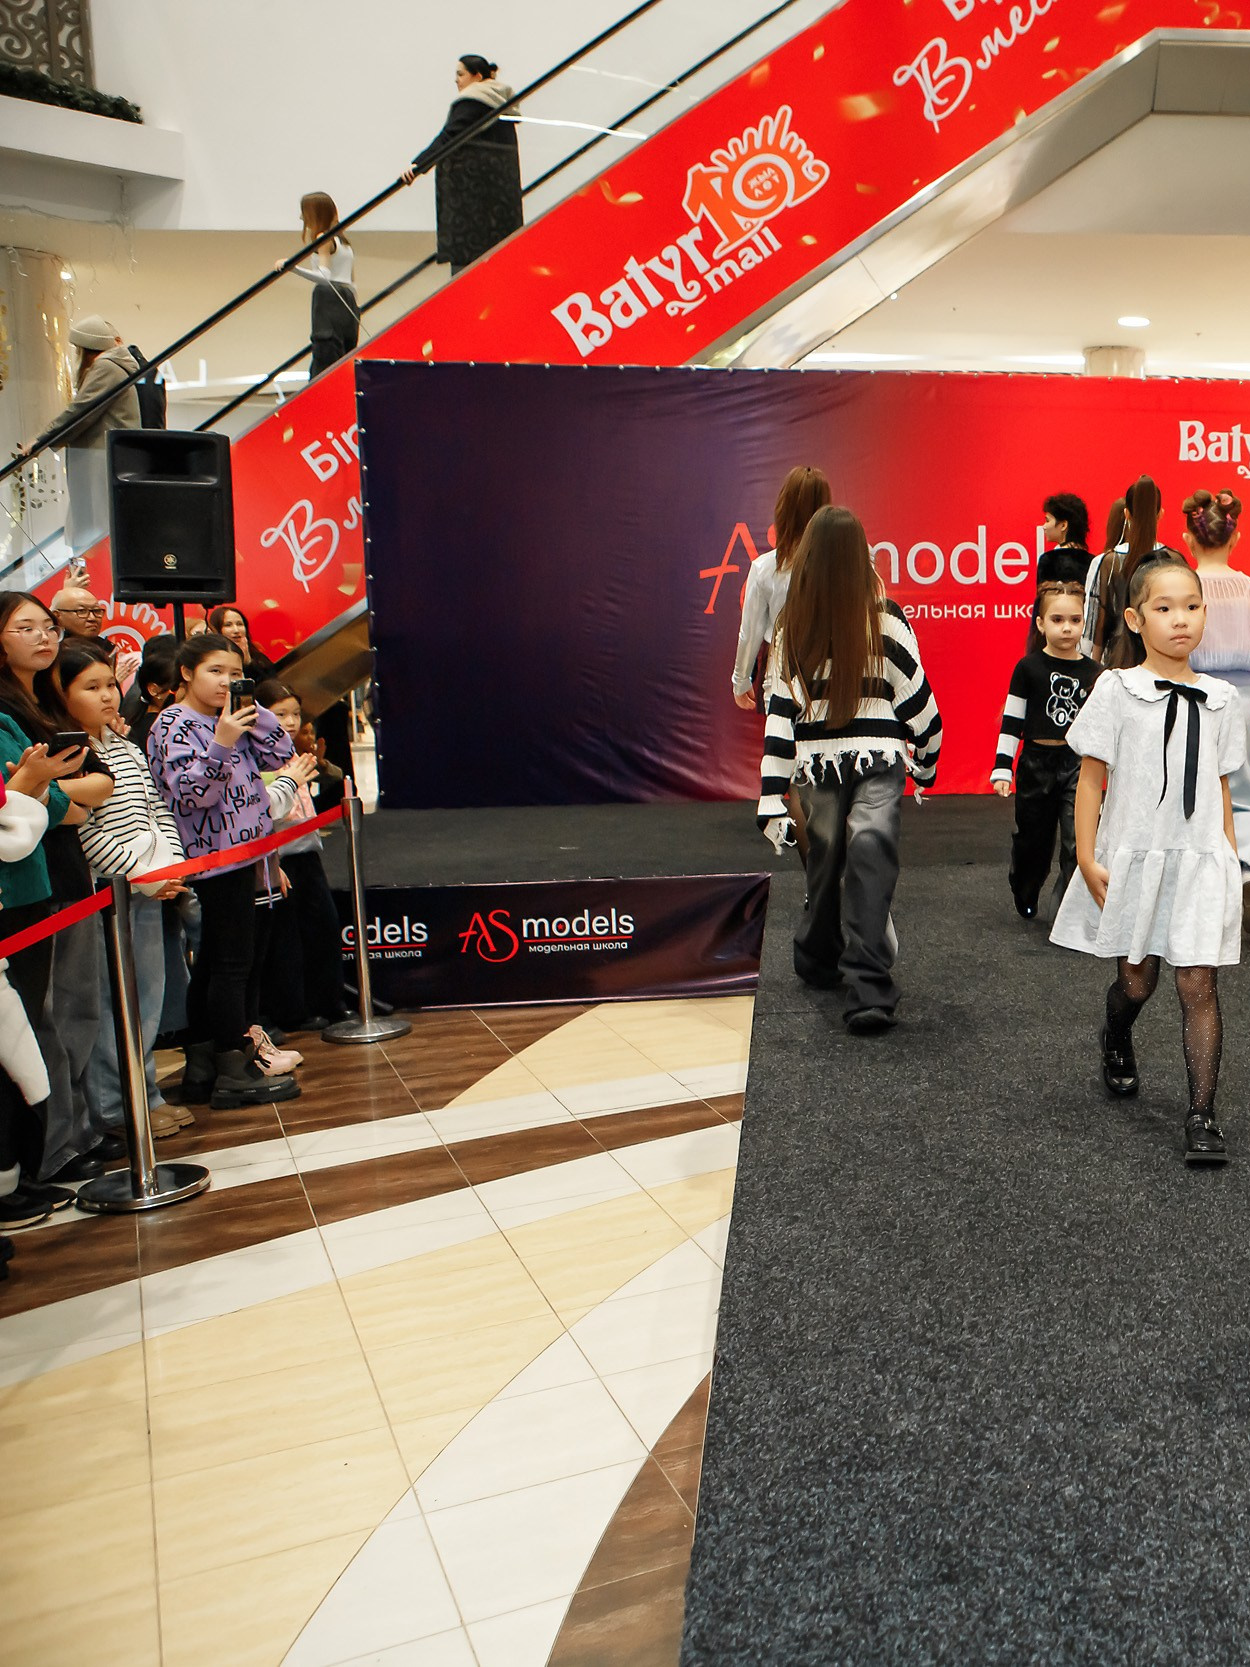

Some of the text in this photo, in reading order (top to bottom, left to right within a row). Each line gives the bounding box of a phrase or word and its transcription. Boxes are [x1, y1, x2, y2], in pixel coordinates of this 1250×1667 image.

[703, 226, 782, 294] mall
[550, 226, 710, 357] Batyr
[300, 423, 360, 483] Бір
[868, 525, 1046, 585] odel
[903, 603, 1033, 619] ельная шко
[341, 915, 429, 946] odels
[458, 908, 635, 963] AS models
[528, 941, 628, 954] модельная школа
